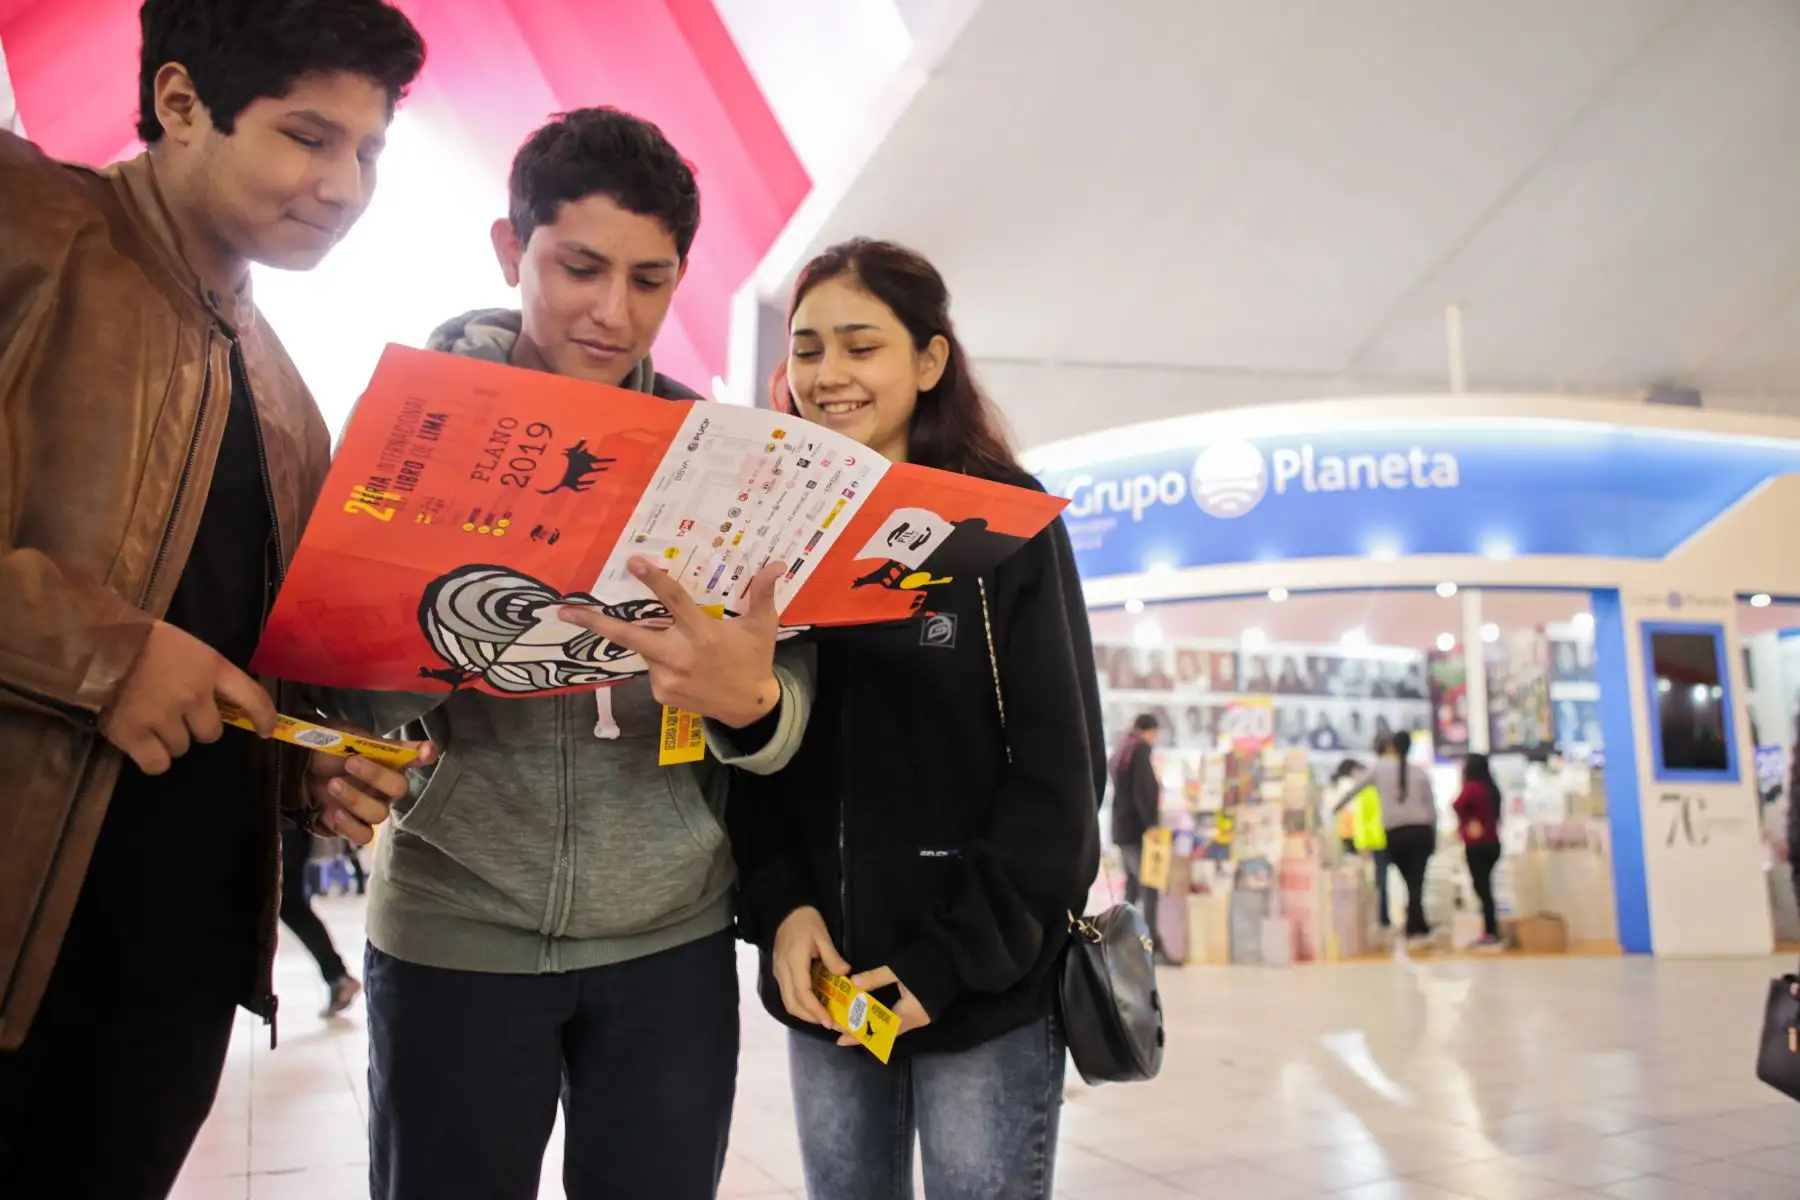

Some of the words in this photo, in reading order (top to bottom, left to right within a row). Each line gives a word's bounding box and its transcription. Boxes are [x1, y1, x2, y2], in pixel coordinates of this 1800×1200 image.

[360, 476, 392, 505] FERIA
[376, 397, 427, 473] INTERNACIONAL
[393, 460, 425, 492] LIBRO
[416, 413, 449, 441] LIMA
[470, 417, 519, 483] PLANO
[500, 422, 553, 488] 2019
[693, 418, 710, 441] PUCP
[674, 459, 690, 481] BBVA
[1065, 471, 1187, 522] Grupo
[1272, 444, 1461, 495] Planeta
[897, 529, 916, 544] FIL
